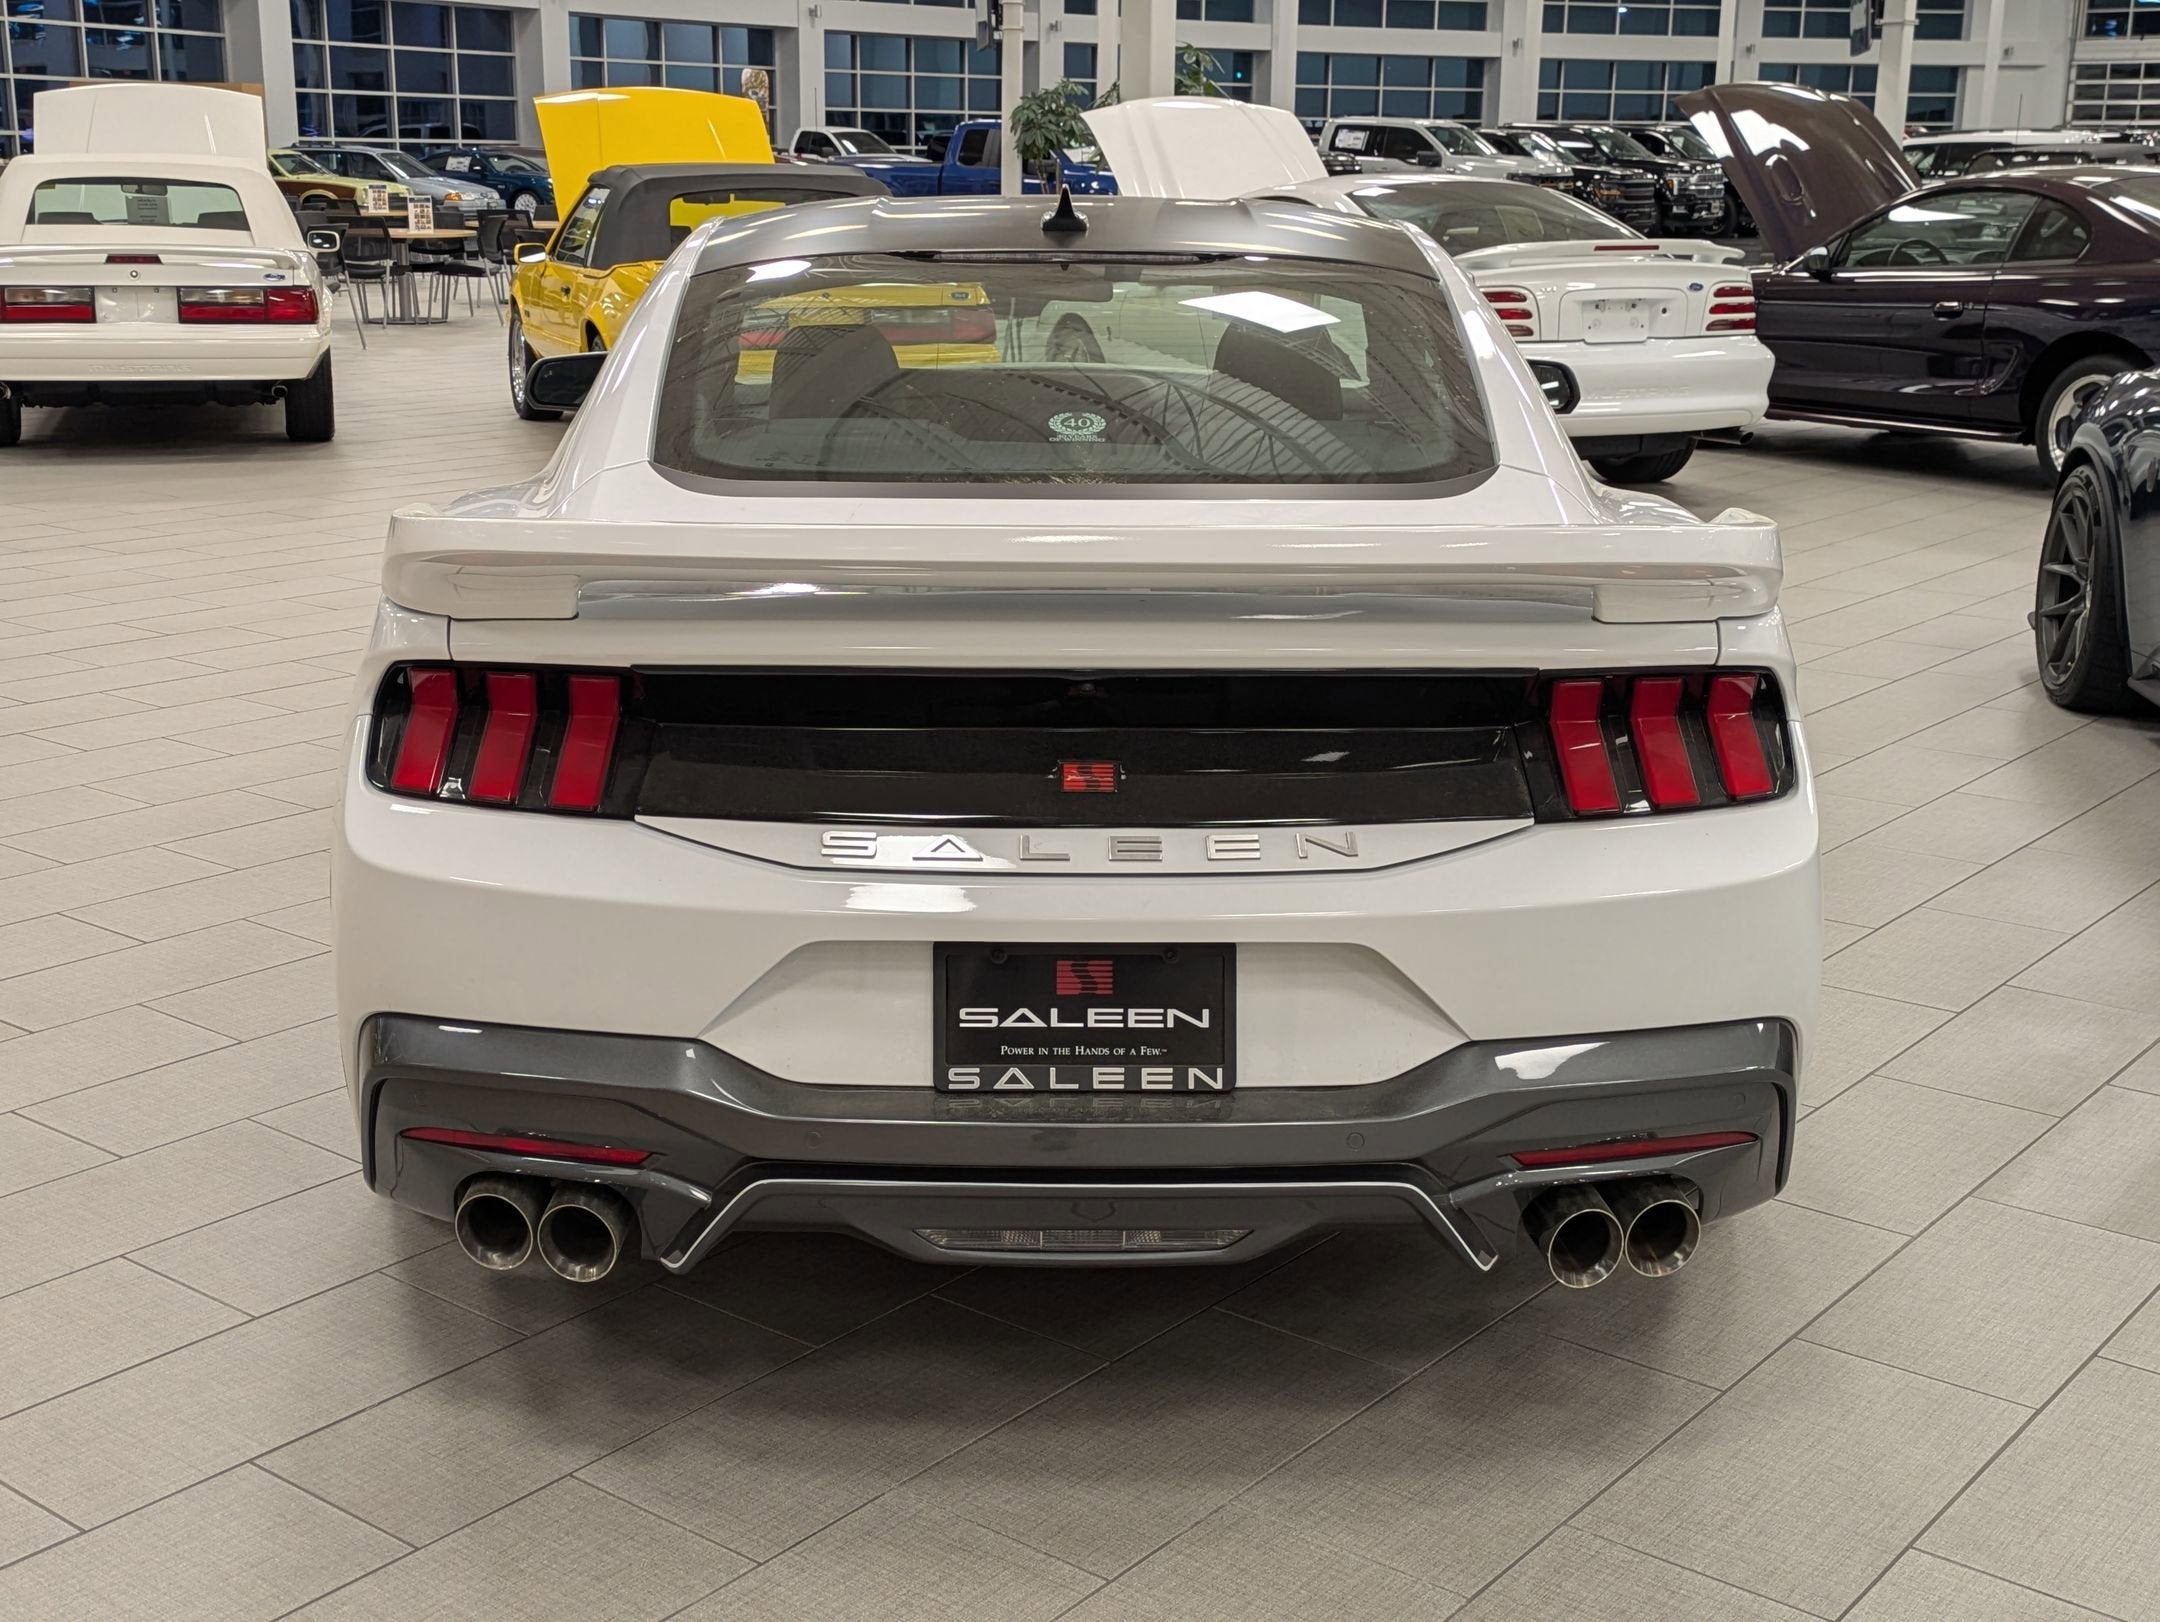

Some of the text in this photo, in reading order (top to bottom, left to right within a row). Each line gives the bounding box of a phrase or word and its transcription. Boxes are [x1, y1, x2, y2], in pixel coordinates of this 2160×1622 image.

[1063, 418, 1091, 428] 40
[820, 830, 1359, 862] SALEEN
[959, 1007, 1210, 1028] SALEEN
[948, 1067, 1223, 1089] SALEEN
